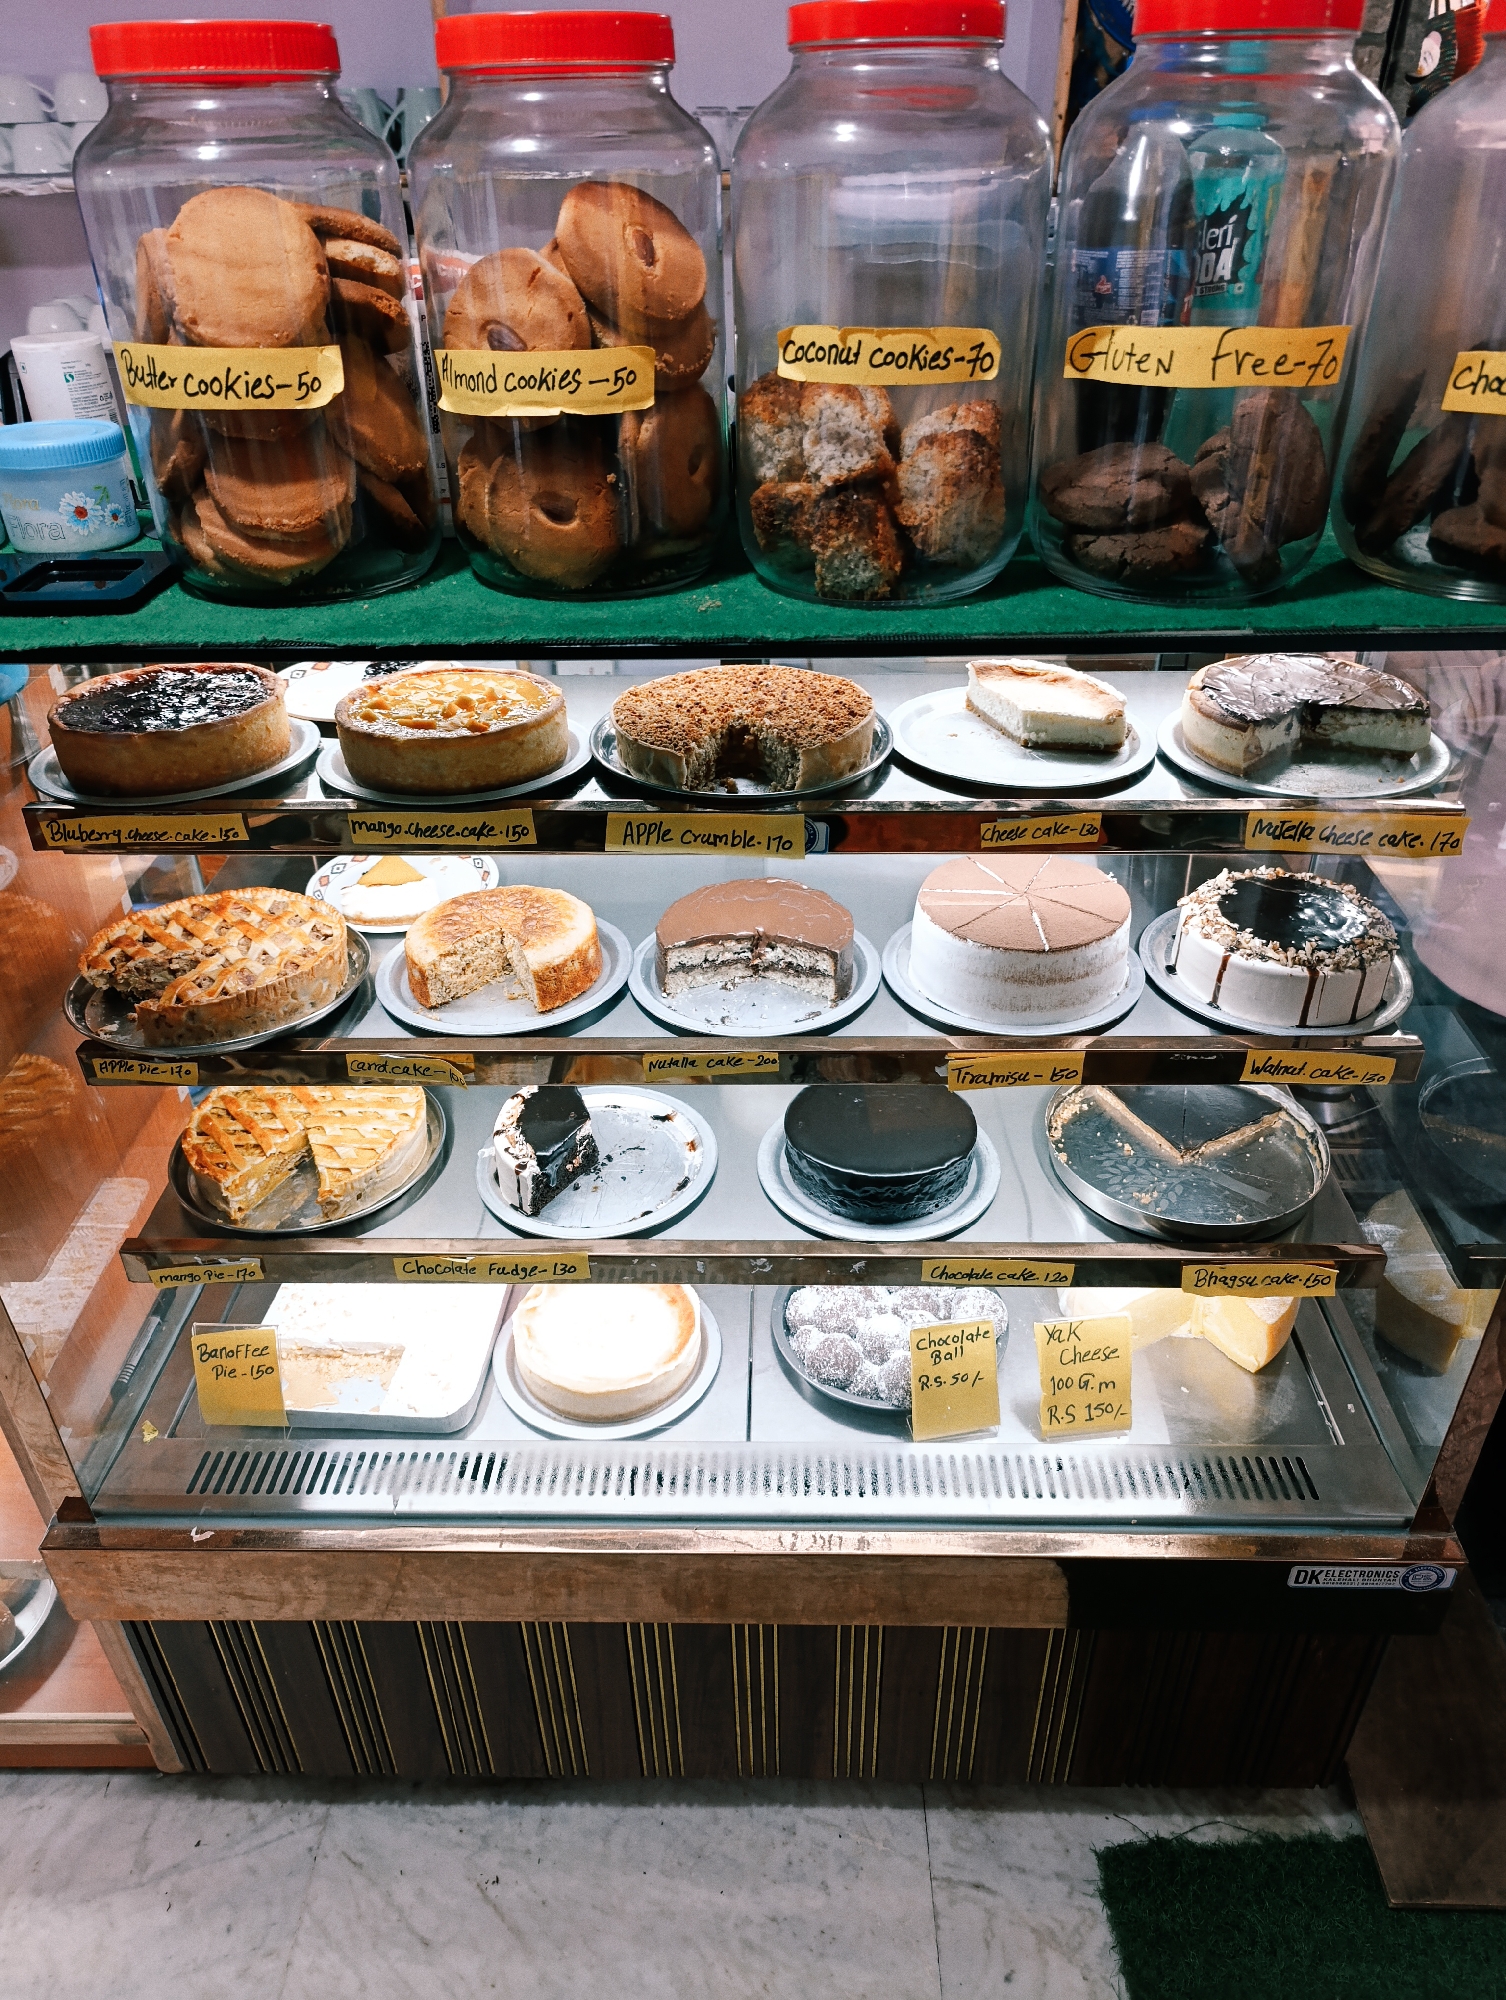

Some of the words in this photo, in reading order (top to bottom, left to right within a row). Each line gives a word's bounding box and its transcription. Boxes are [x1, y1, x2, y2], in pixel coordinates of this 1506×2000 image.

[121, 349, 177, 391] Butter
[442, 352, 498, 394] Almond
[930, 1345, 964, 1366] Ball
[1294, 1569, 1324, 1585] DK
[1324, 1569, 1400, 1579] ELECTRONICS
